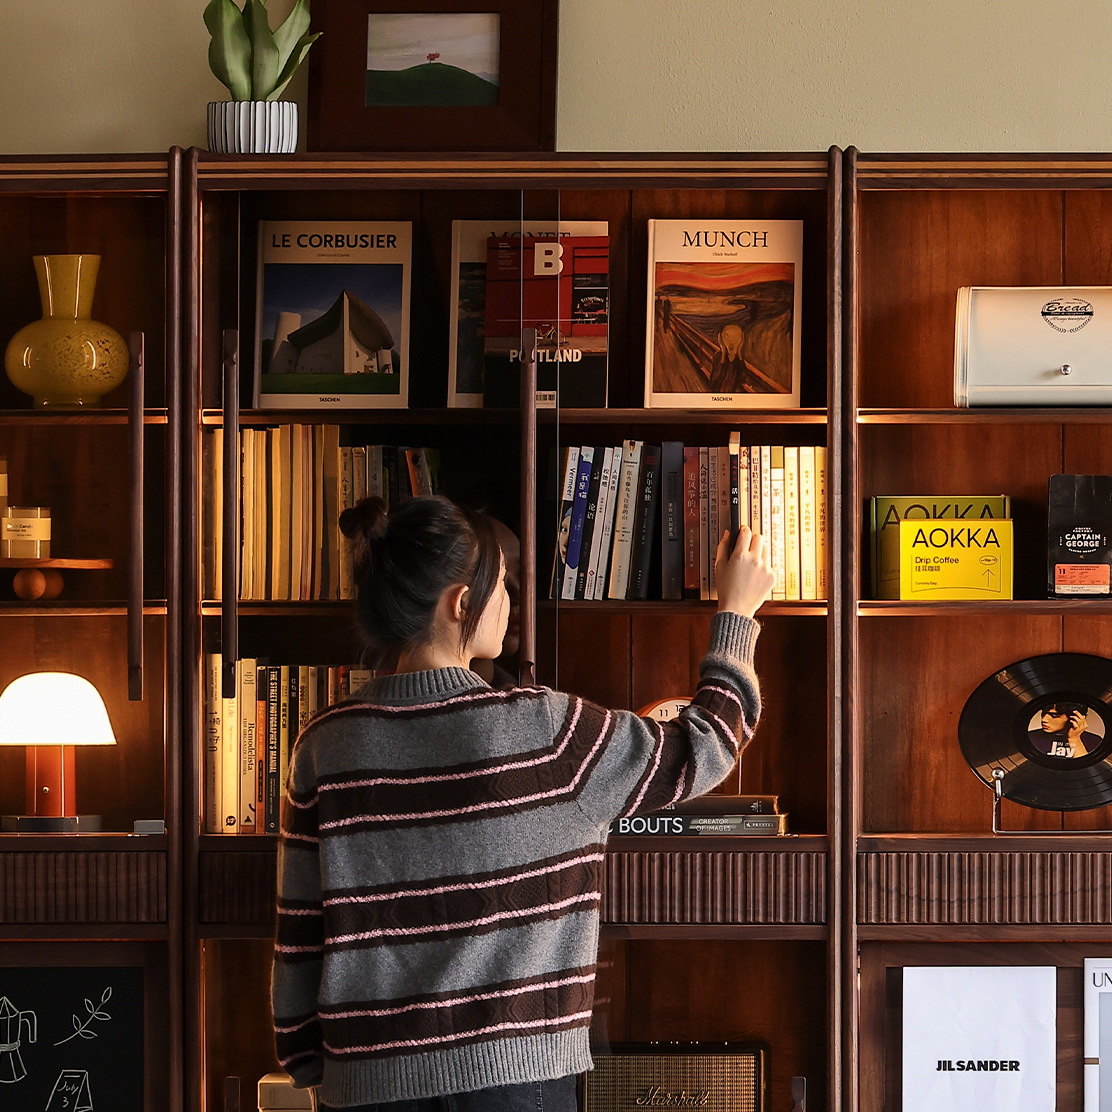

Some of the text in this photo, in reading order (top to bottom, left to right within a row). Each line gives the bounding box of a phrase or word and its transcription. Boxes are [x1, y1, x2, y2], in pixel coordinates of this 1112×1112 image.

[272, 233, 397, 249] LE CORBUSIER
[682, 230, 769, 248] MUNCH
[534, 242, 564, 276] B
[1046, 301, 1091, 311] Bread
[509, 349, 583, 363] PTLAND
[566, 467, 576, 497] Vermeer
[687, 472, 696, 517] 追风筝的人
[912, 528, 1001, 548] AOKKA
[915, 556, 959, 565] Drip Coffee
[659, 709, 668, 717] 11
[247, 722, 256, 771] Remodelista
[1047, 741, 1075, 758] Jay
[619, 817, 683, 834] BOUTS
[936, 1059, 1020, 1072] JIL SANDER
[62, 1096, 70, 1108] 3
[636, 1086, 710, 1107] Marshall
